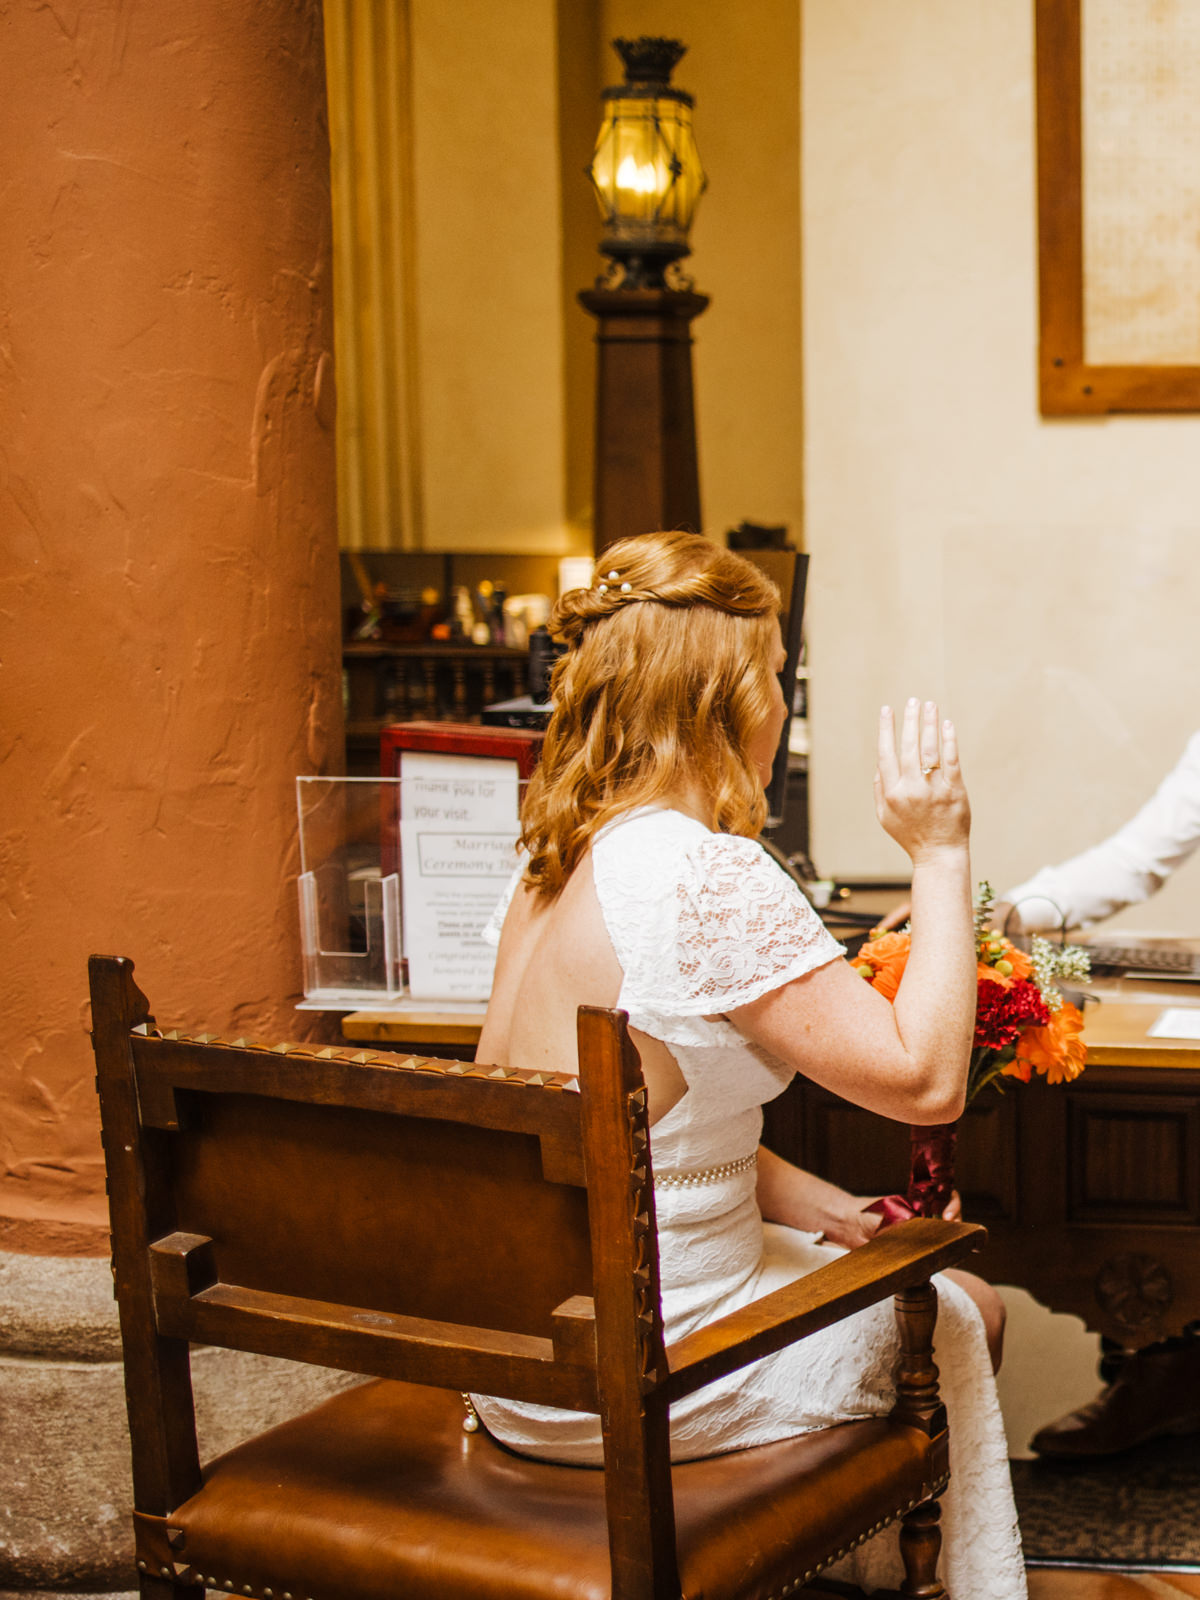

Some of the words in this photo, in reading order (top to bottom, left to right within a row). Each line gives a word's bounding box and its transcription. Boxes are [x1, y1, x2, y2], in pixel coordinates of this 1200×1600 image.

[413, 776, 449, 793] Thank
[453, 781, 475, 798] you
[479, 780, 496, 798] for
[414, 806, 440, 820] your
[452, 838, 516, 855] Marriag
[423, 858, 494, 872] Ceremony
